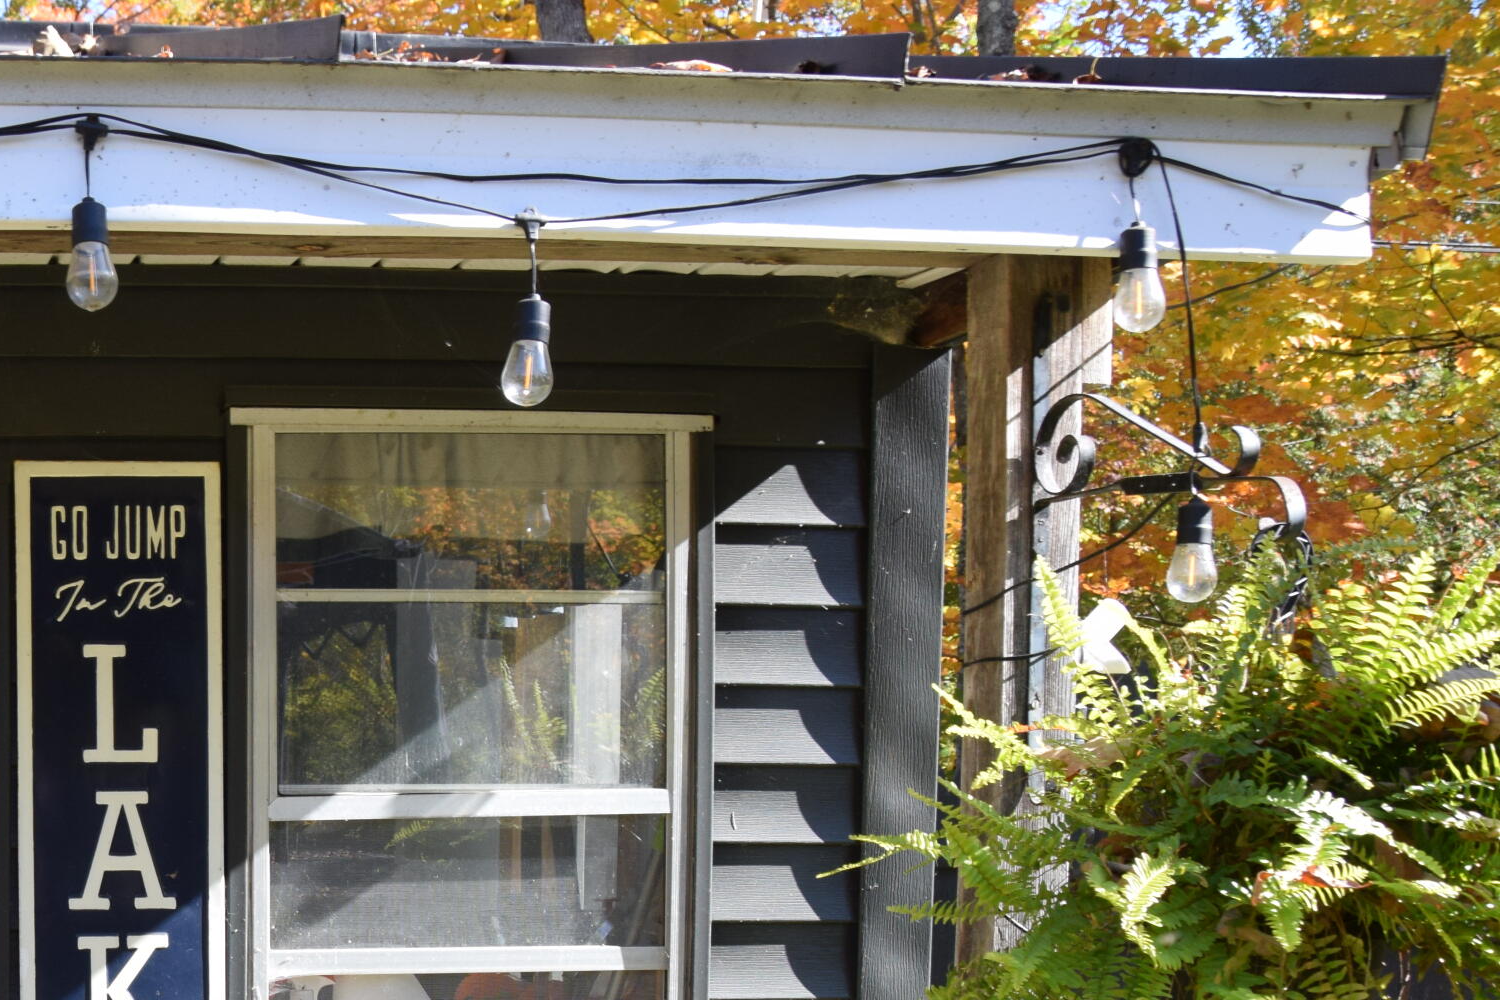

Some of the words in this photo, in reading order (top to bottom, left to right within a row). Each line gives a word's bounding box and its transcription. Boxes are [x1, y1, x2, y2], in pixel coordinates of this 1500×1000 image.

[50, 505, 88, 560] GO
[106, 504, 186, 560] JUMP
[55, 579, 106, 622] In
[113, 576, 182, 618] The
